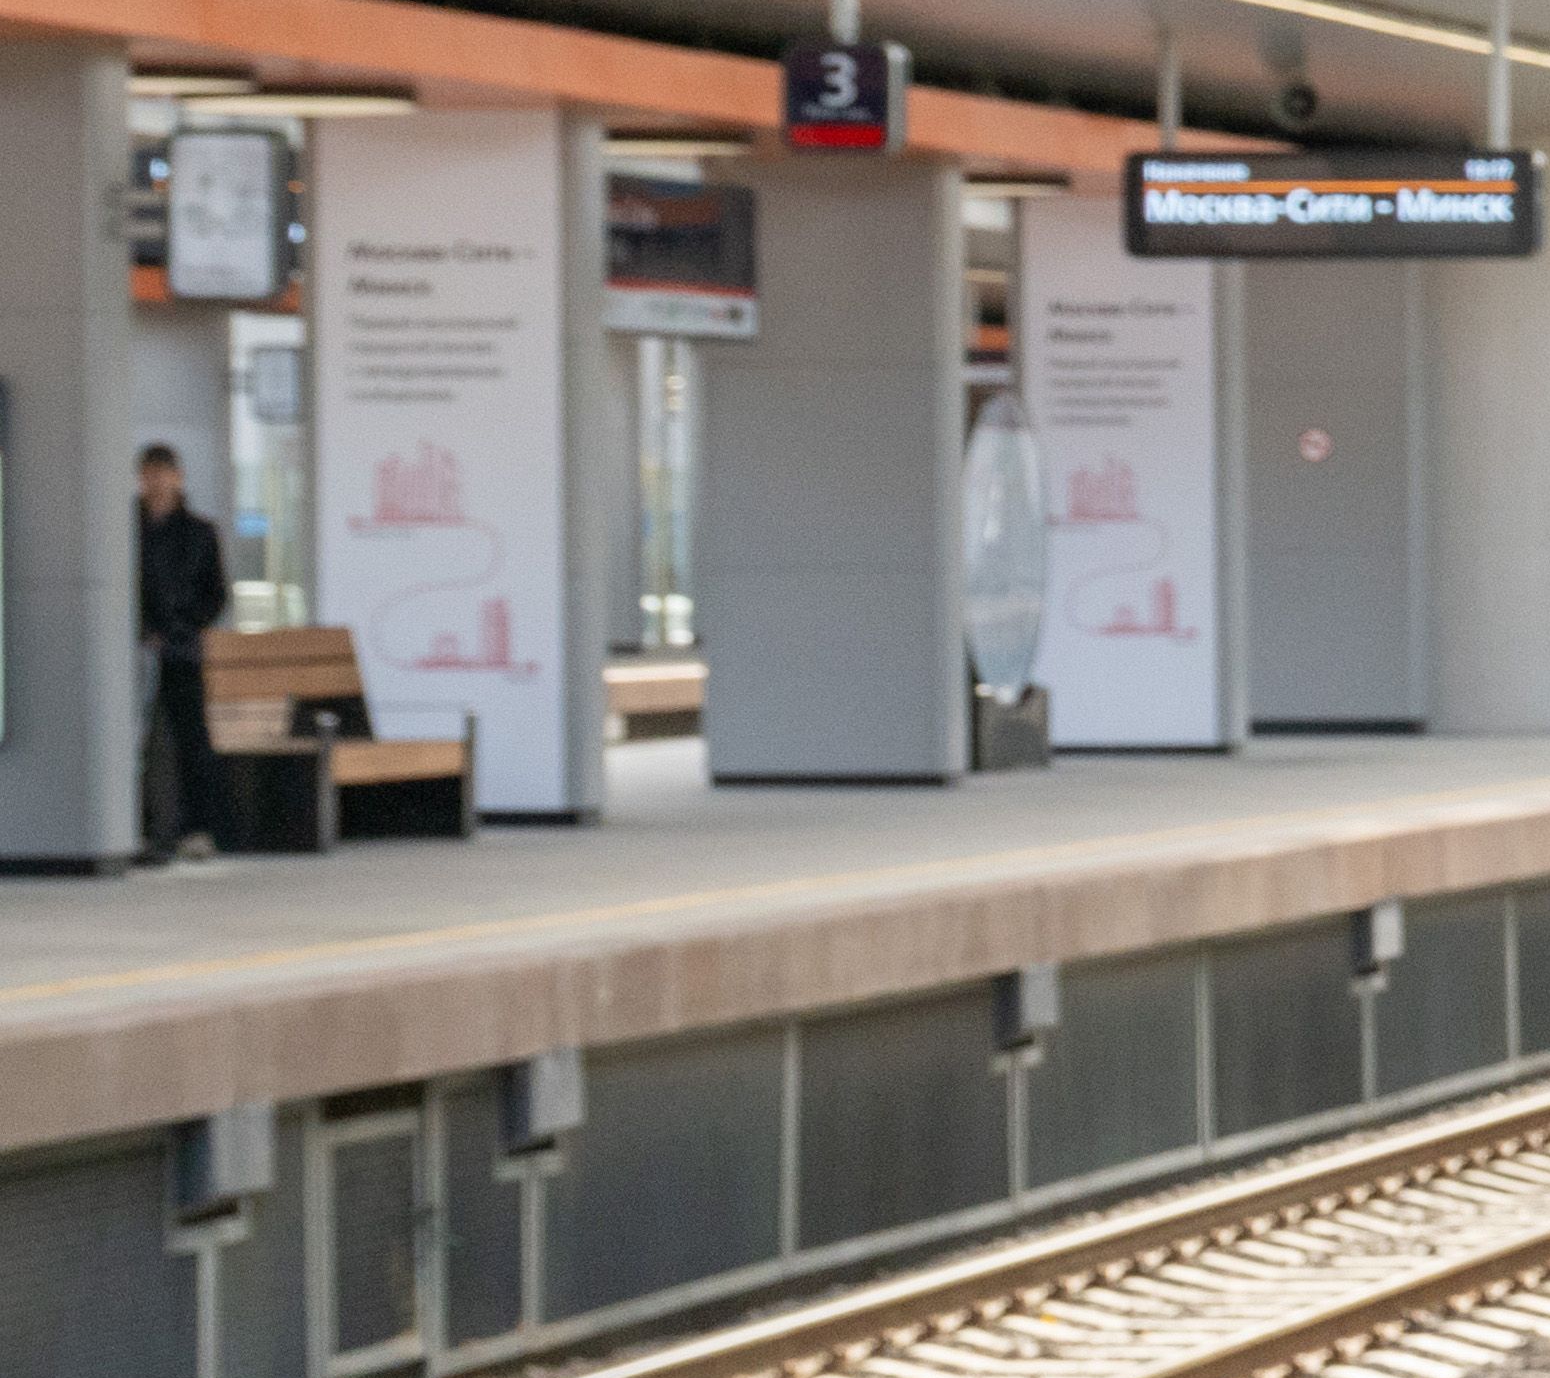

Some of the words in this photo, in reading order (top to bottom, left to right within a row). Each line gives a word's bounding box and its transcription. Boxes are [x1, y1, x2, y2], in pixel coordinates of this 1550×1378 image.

[820, 52, 858, 108] 3
[1144, 188, 1374, 224] Москва-Сити
[1396, 188, 1514, 223] Минск
